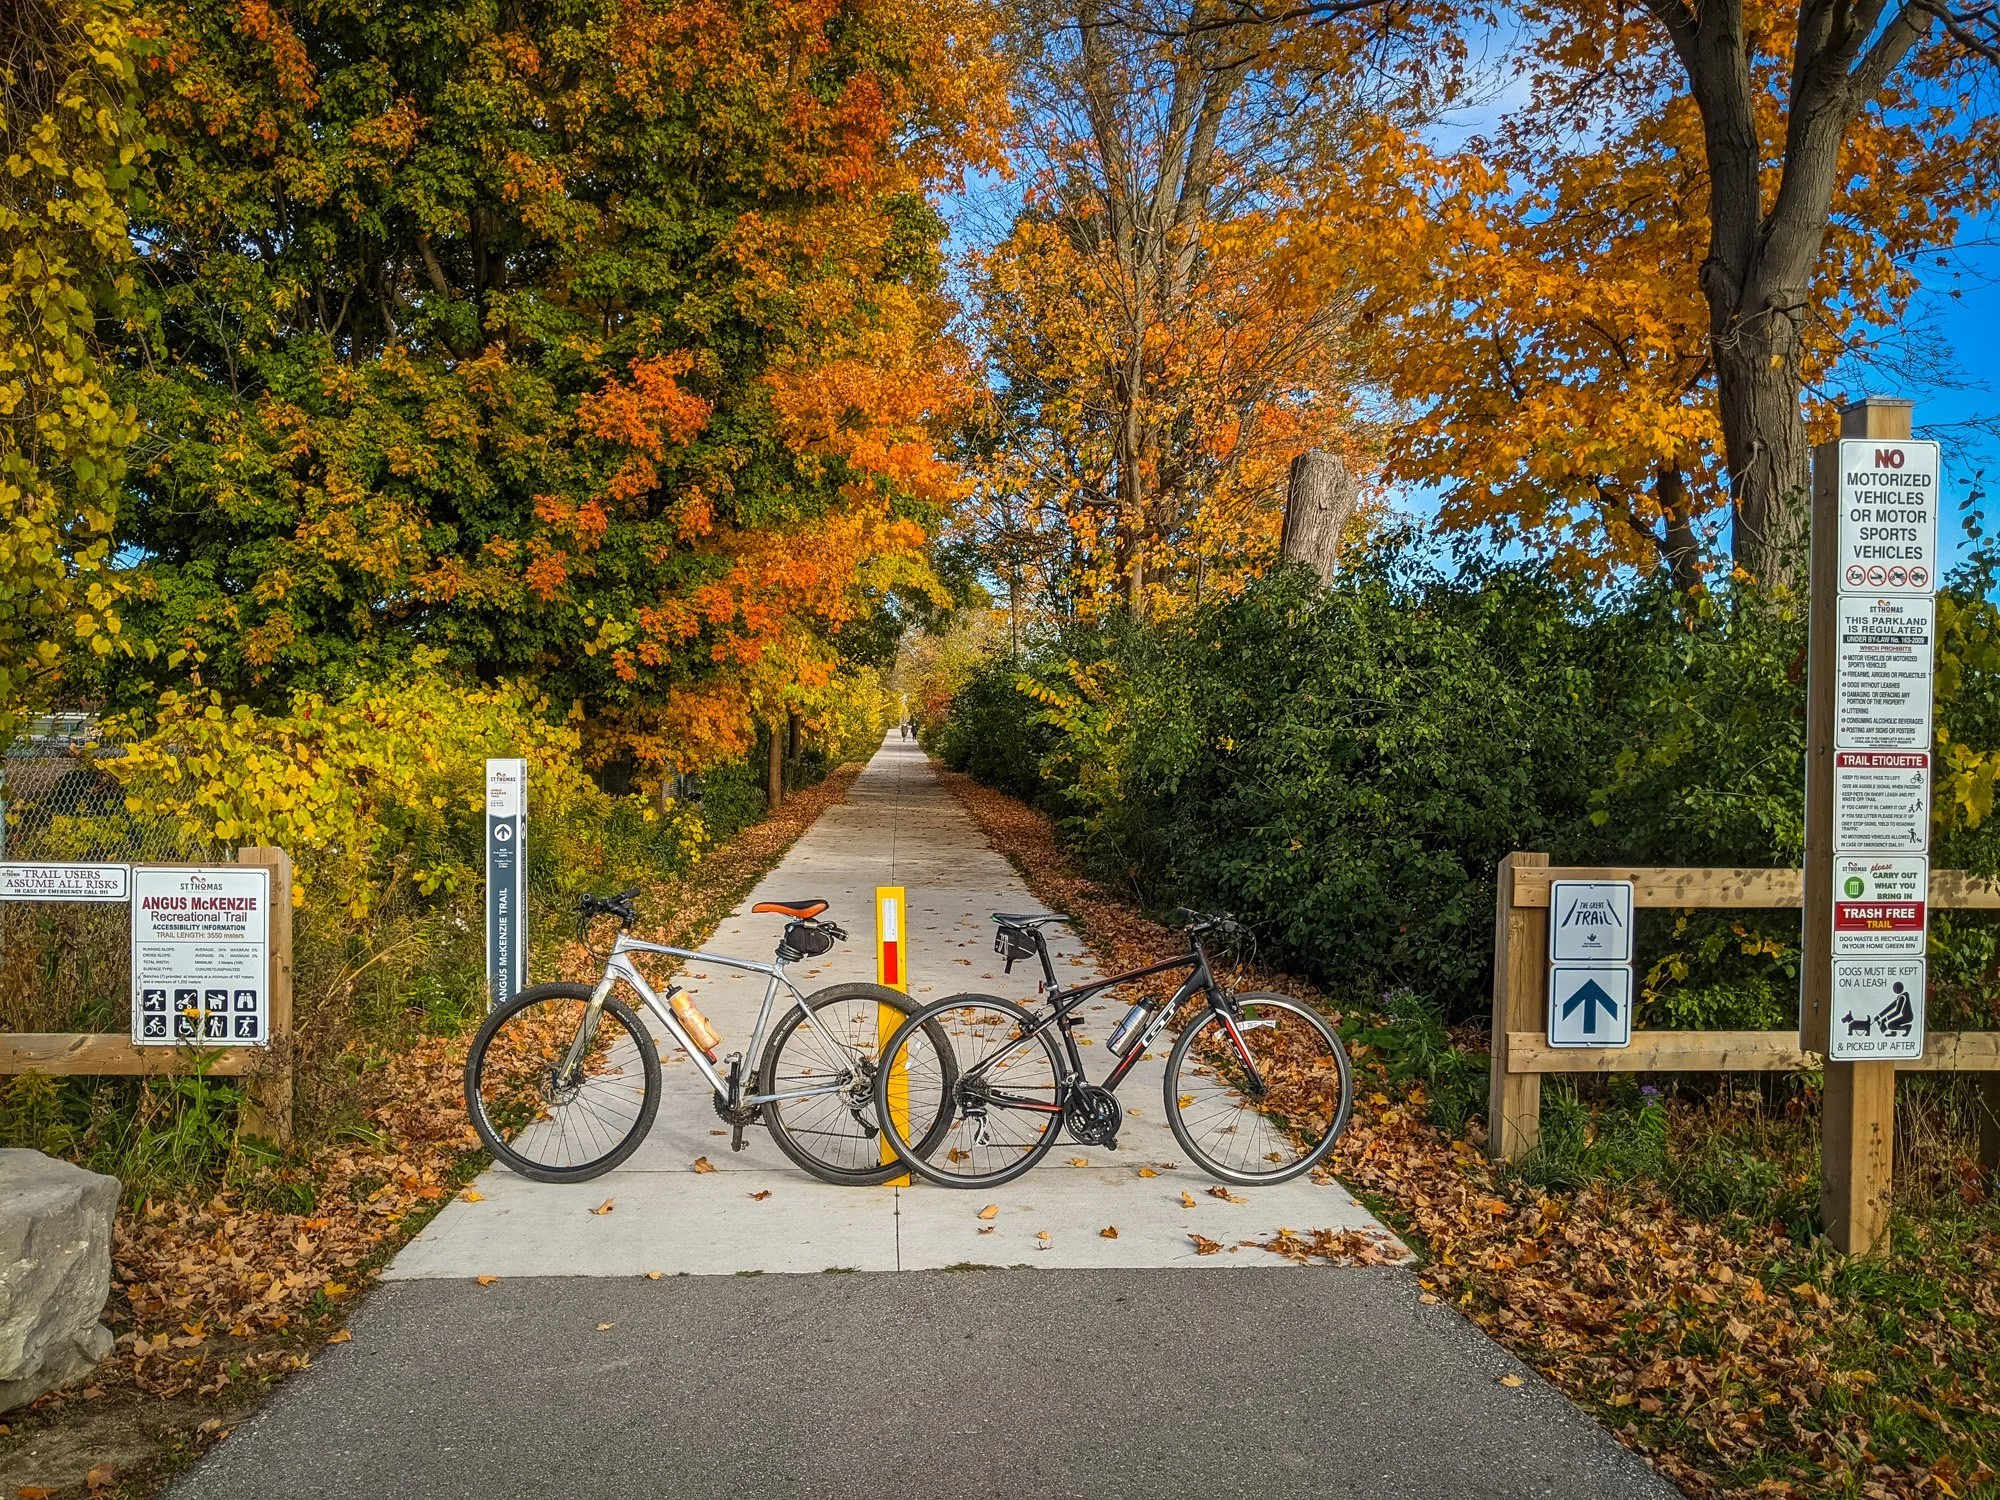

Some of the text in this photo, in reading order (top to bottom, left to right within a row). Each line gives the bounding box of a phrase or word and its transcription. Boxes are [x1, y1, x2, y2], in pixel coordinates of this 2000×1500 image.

[1875, 449, 1905, 469] NO
[1847, 472, 1931, 487] MOTORIZED
[1854, 491, 1924, 505] VEHICLES
[1850, 509, 1926, 523] OR MOTOR
[1860, 527, 1916, 541] SPORTS
[1854, 546, 1922, 559] VEHICLES
[1872, 617, 1927, 625] PARKLAND
[1862, 626, 1923, 634] REGULATED
[1842, 756, 1922, 766] TRAIL ETIQUETTE
[1870, 863, 1892, 874] please
[22, 870, 60, 878] TRAIL
[65, 871, 100, 879] USERS
[86, 881, 118, 889] RISKS
[142, 897, 256, 910] ANGUS McKENZIE
[151, 911, 247, 922] Recreational Trail
[1843, 908, 1915, 918] TRASH FREE
[1839, 967, 1918, 975] DOGS MUST BE KEPT
[1839, 979, 1886, 987] ON A LEASH
